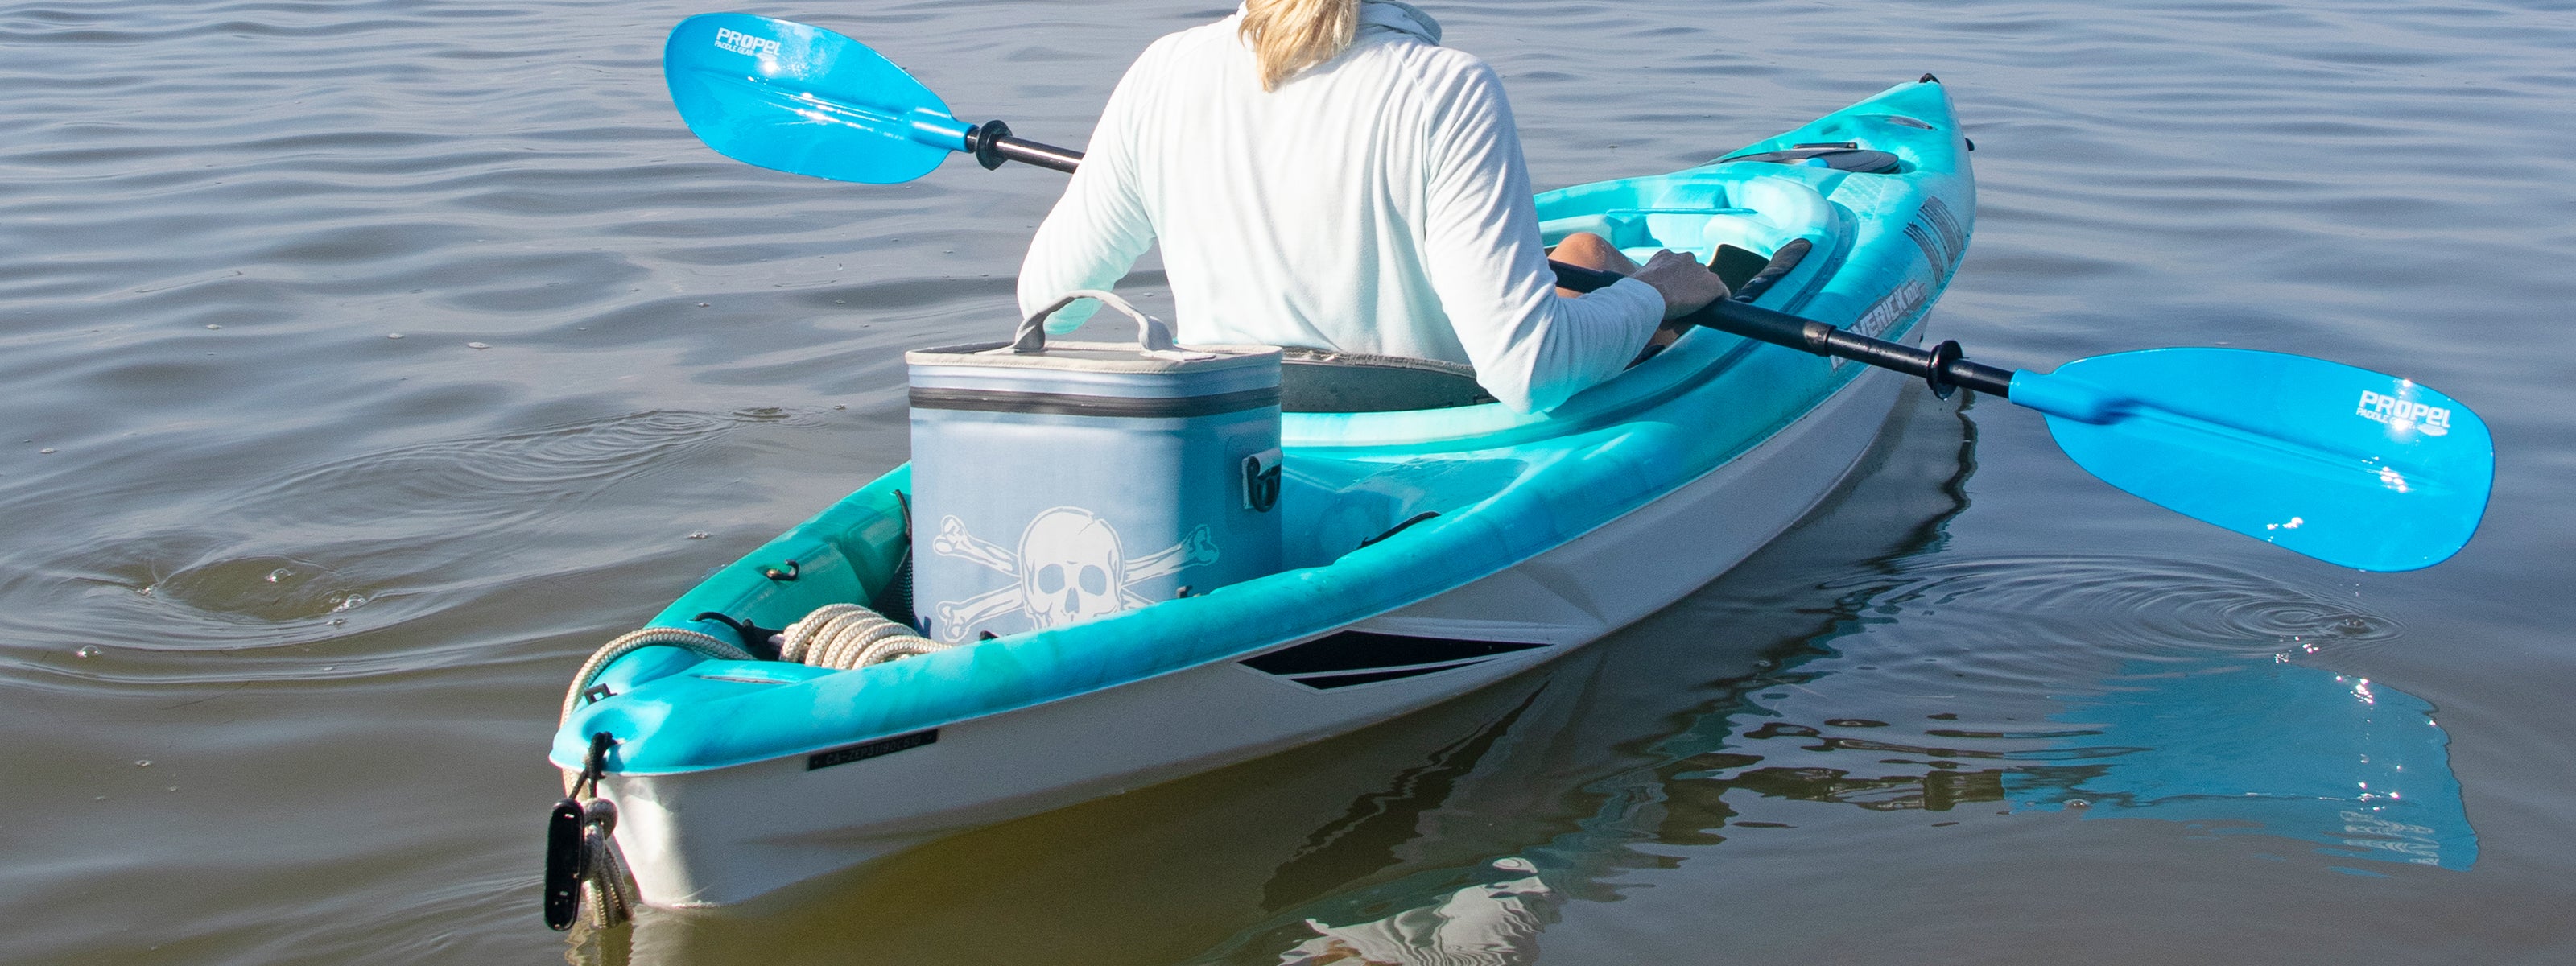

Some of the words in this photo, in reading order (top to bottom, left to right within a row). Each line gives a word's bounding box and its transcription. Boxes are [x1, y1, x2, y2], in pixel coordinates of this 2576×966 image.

[714, 40, 737, 52] PADDLE
[737, 47, 754, 56] GEAR
[2356, 407, 2390, 424] PADDLE
